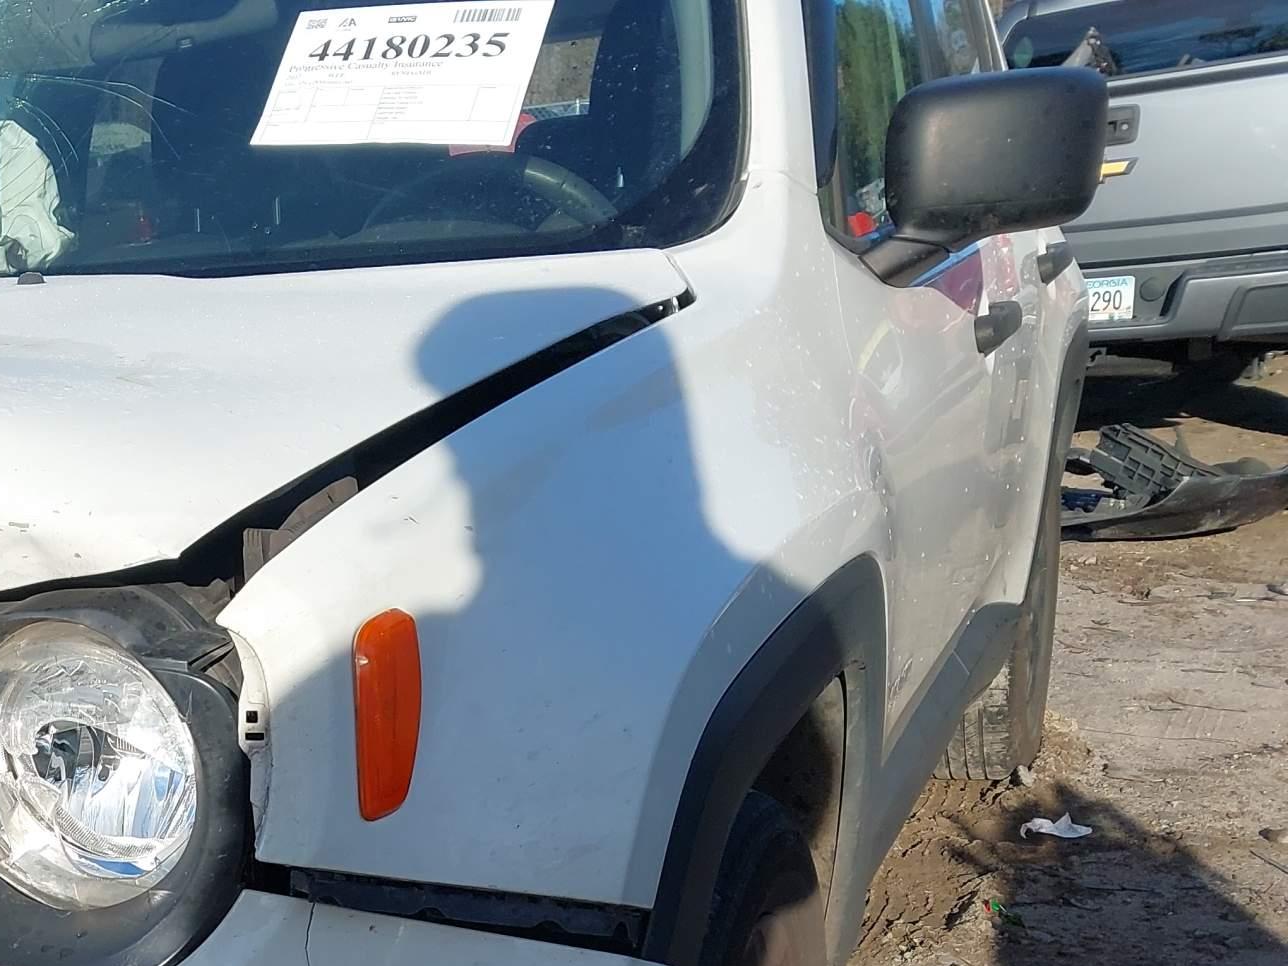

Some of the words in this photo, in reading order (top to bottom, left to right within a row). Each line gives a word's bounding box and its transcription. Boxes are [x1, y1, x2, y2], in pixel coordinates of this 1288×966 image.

[308, 32, 510, 62] 44180235
[347, 61, 390, 71] Casualty
[393, 60, 444, 69] Insurance
[1087, 279, 1128, 289] EORGIA
[1091, 290, 1122, 312] 290
